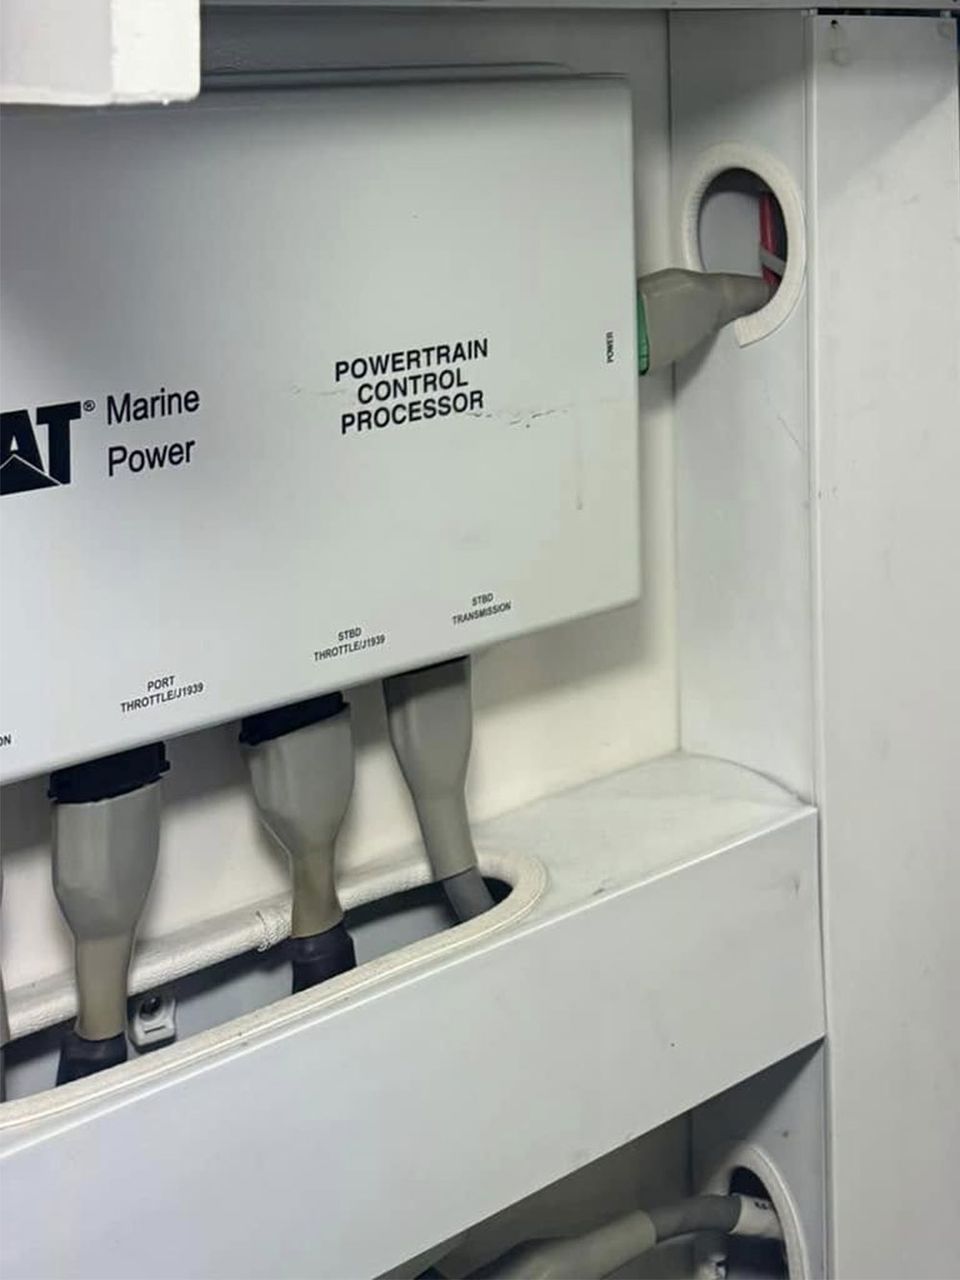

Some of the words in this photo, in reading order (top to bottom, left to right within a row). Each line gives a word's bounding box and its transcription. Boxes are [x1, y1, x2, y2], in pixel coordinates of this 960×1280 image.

[335, 338, 488, 382] POWERTRAIN
[357, 367, 469, 405] CONTROL
[107, 387, 200, 425] Marine
[341, 390, 484, 435] PROCESSOR
[108, 440, 196, 477] Power
[452, 600, 511, 625] TRANSMISSION
[472, 593, 494, 607] STBD
[338, 627, 362, 641] STBD
[120, 682, 204, 713] THROTTLE/J1939
[147, 675, 175, 692] PORT
